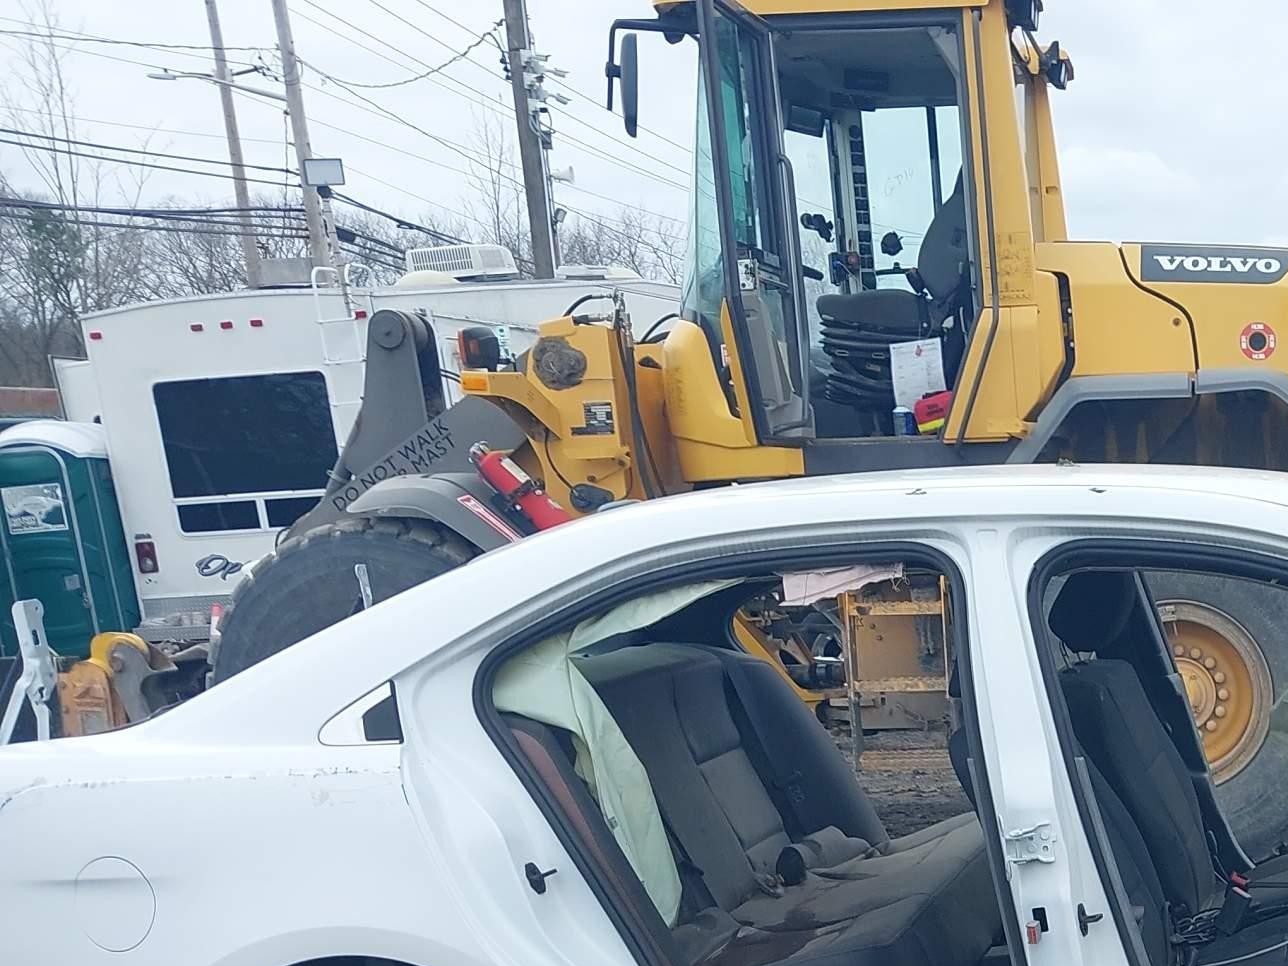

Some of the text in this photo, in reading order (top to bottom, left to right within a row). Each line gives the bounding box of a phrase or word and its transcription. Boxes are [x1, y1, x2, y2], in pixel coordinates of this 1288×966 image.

[1152, 255, 1281, 273] VOLVO
[331, 418, 449, 512] DO NOT WALK
[410, 432, 455, 473] MAST
[195, 553, 244, 581] Op
